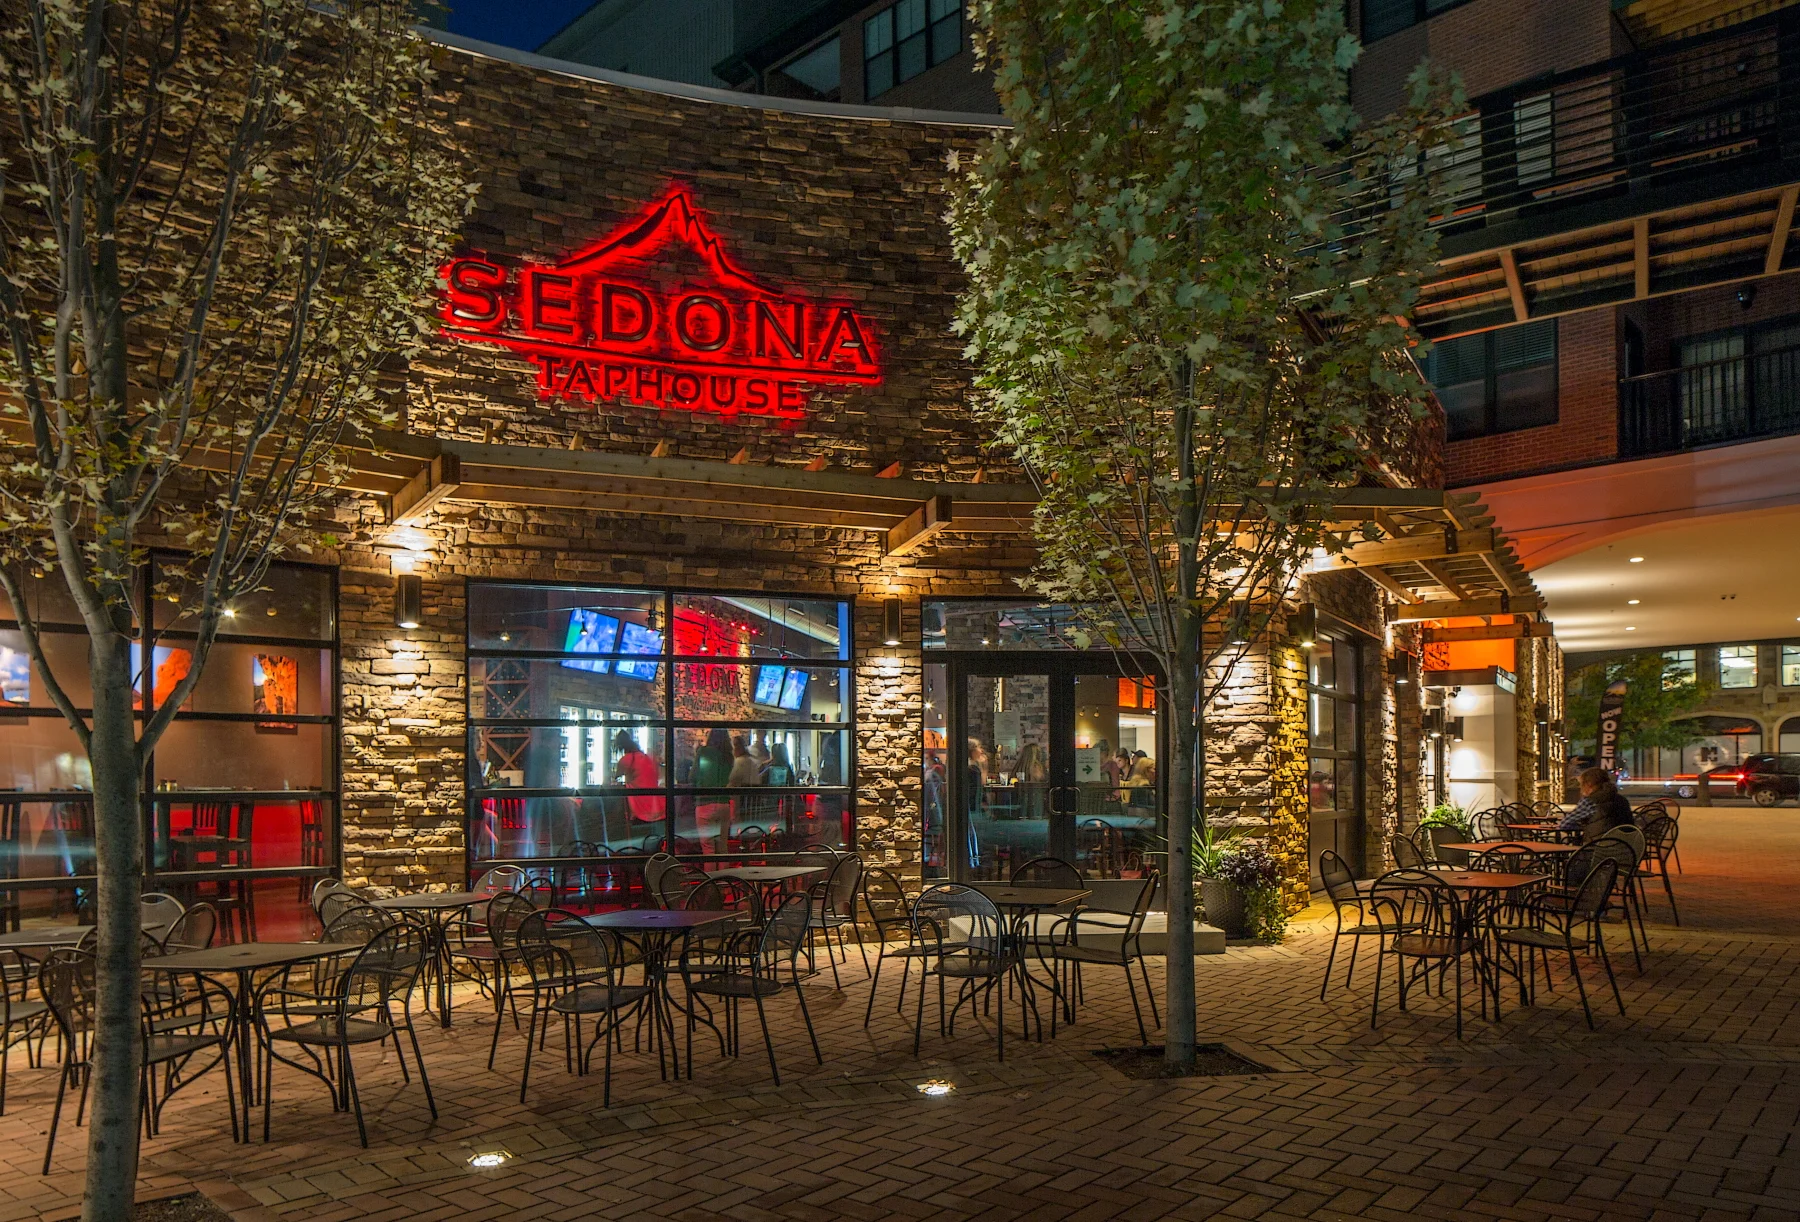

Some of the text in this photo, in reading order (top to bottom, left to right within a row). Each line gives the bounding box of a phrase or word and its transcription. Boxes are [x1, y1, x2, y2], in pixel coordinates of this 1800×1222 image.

[451, 261, 875, 365] SEDONA
[538, 355, 800, 411] TAPHOUSE
[1601, 707, 1622, 720] NOW
[1601, 720, 1617, 770] OPEN
